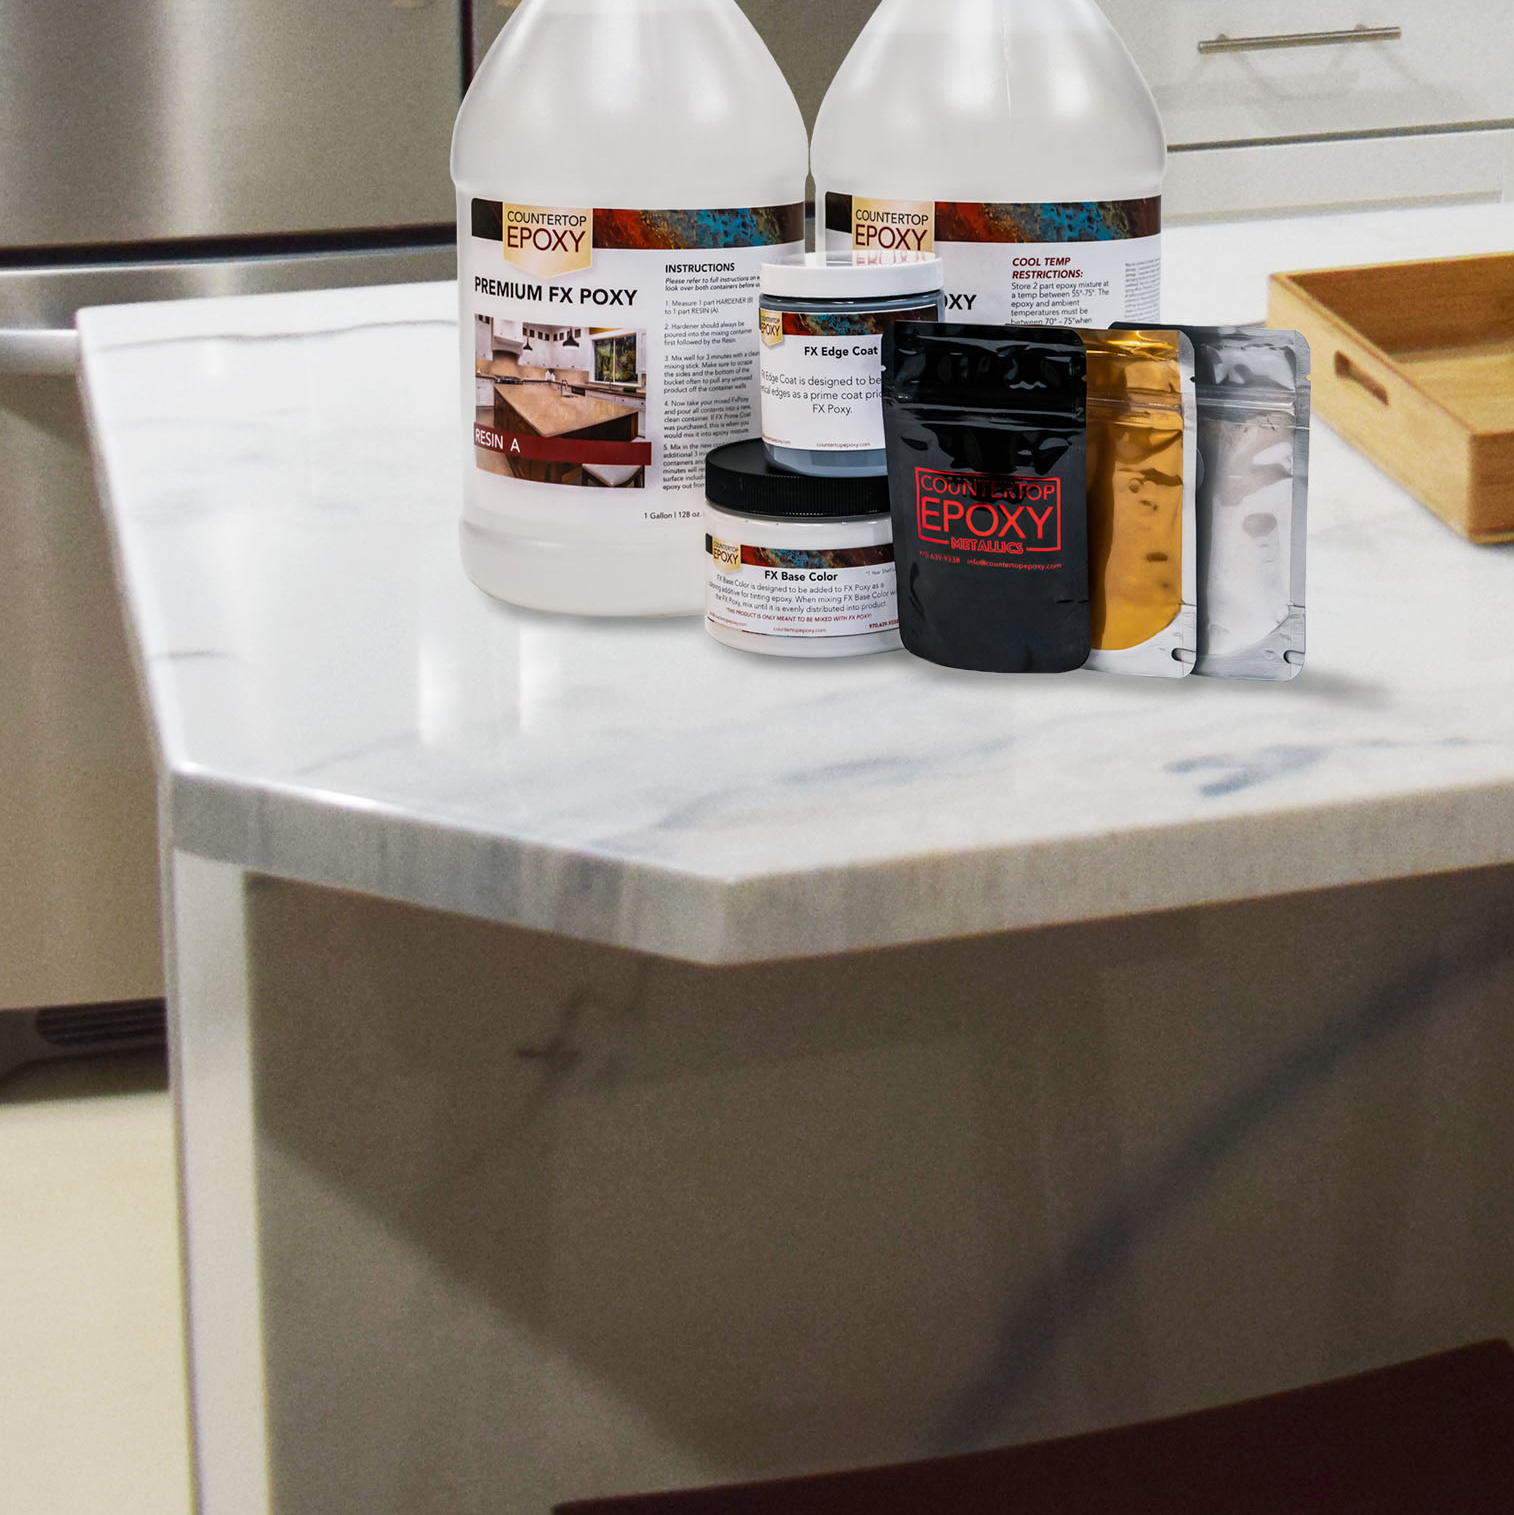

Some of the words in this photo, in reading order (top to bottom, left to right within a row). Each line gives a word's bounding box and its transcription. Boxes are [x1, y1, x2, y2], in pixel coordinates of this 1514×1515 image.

[507, 211, 587, 227] COUNTERTOP
[856, 209, 928, 225] COUNTERTOP
[507, 226, 586, 253] EPOXY
[856, 224, 928, 251] EPOXY
[665, 263, 735, 273] INSTRUCTIONS
[1013, 258, 1041, 266] COOL
[1045, 257, 1070, 266] TEMP
[1012, 270, 1083, 279] RESTRICTIONS:
[475, 276, 542, 301] PREMIUM
[550, 287, 573, 304] FX
[580, 288, 638, 305] POXY
[1040, 283, 1054, 291] part
[1056, 283, 1077, 291] epoxy
[945, 294, 977, 310] XY
[1018, 292, 1037, 300] temp
[1040, 290, 1070, 298] between
[1011, 309, 1059, 317] temperatures
[804, 347, 818, 356] FX
[822, 347, 848, 358] Edge
[852, 346, 878, 355] Coat
[780, 374, 797, 385] Coat
[800, 376, 805, 385] is
[808, 376, 852, 388] designed
[856, 377, 865, 385] to
[869, 376, 880, 385] be
[772, 386, 790, 399] edges
[803, 391, 808, 399] a
[811, 391, 838, 403] prime
[841, 391, 862, 399] coat
[812, 404, 825, 413] FX
[828, 405, 852, 415] Poxy.
[475, 428, 503, 449] RESIN
[510, 438, 520, 452] A
[922, 496, 1053, 540] EPOXY
[951, 537, 1023, 555] METALLICS
[714, 548, 738, 564] EPOXY
[765, 571, 777, 580] FX
[782, 572, 805, 581] Base
[809, 572, 838, 581] Color
[735, 579, 749, 587] Color
[757, 584, 787, 593] designed
[855, 583, 871, 591] Poxy
[750, 593, 770, 602] tinting
[818, 596, 842, 604] mixing
[782, 606, 804, 615] evenly
